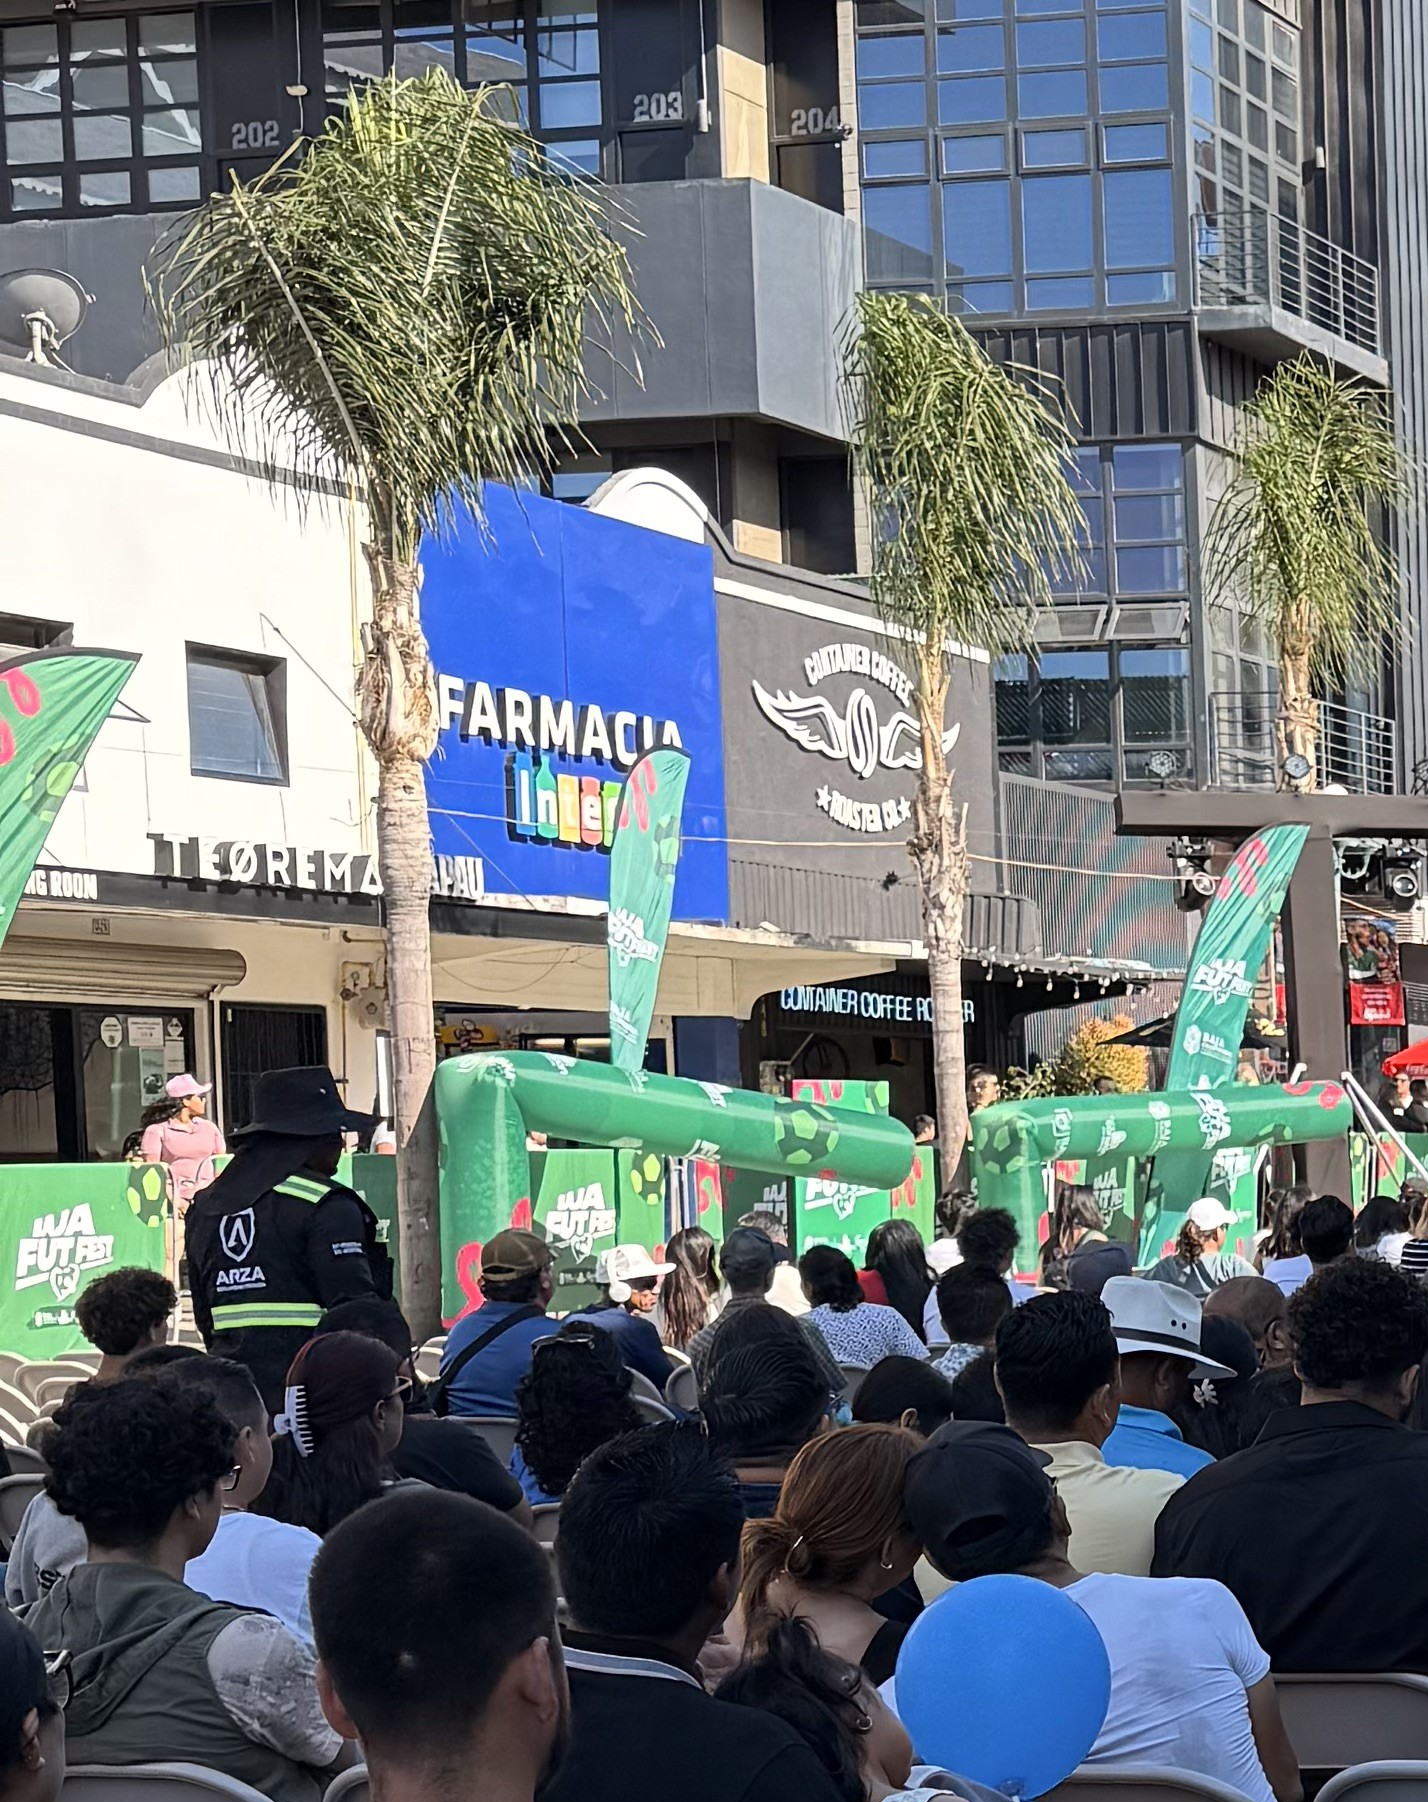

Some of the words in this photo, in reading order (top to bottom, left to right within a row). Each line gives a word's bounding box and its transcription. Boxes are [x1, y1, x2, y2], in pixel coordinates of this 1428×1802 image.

[633, 91, 684, 122] 203
[790, 106, 839, 136] 204
[231, 120, 279, 149] 202
[803, 643, 870, 686] CONTAINER
[438, 672, 683, 767] FARMACIA
[829, 790, 882, 833] ROASTER
[163, 836, 385, 896] TEØREMA
[780, 986, 858, 1015] CONTAINER
[860, 992, 912, 1021] COFFEE
[216, 1266, 266, 1286] ARZA
